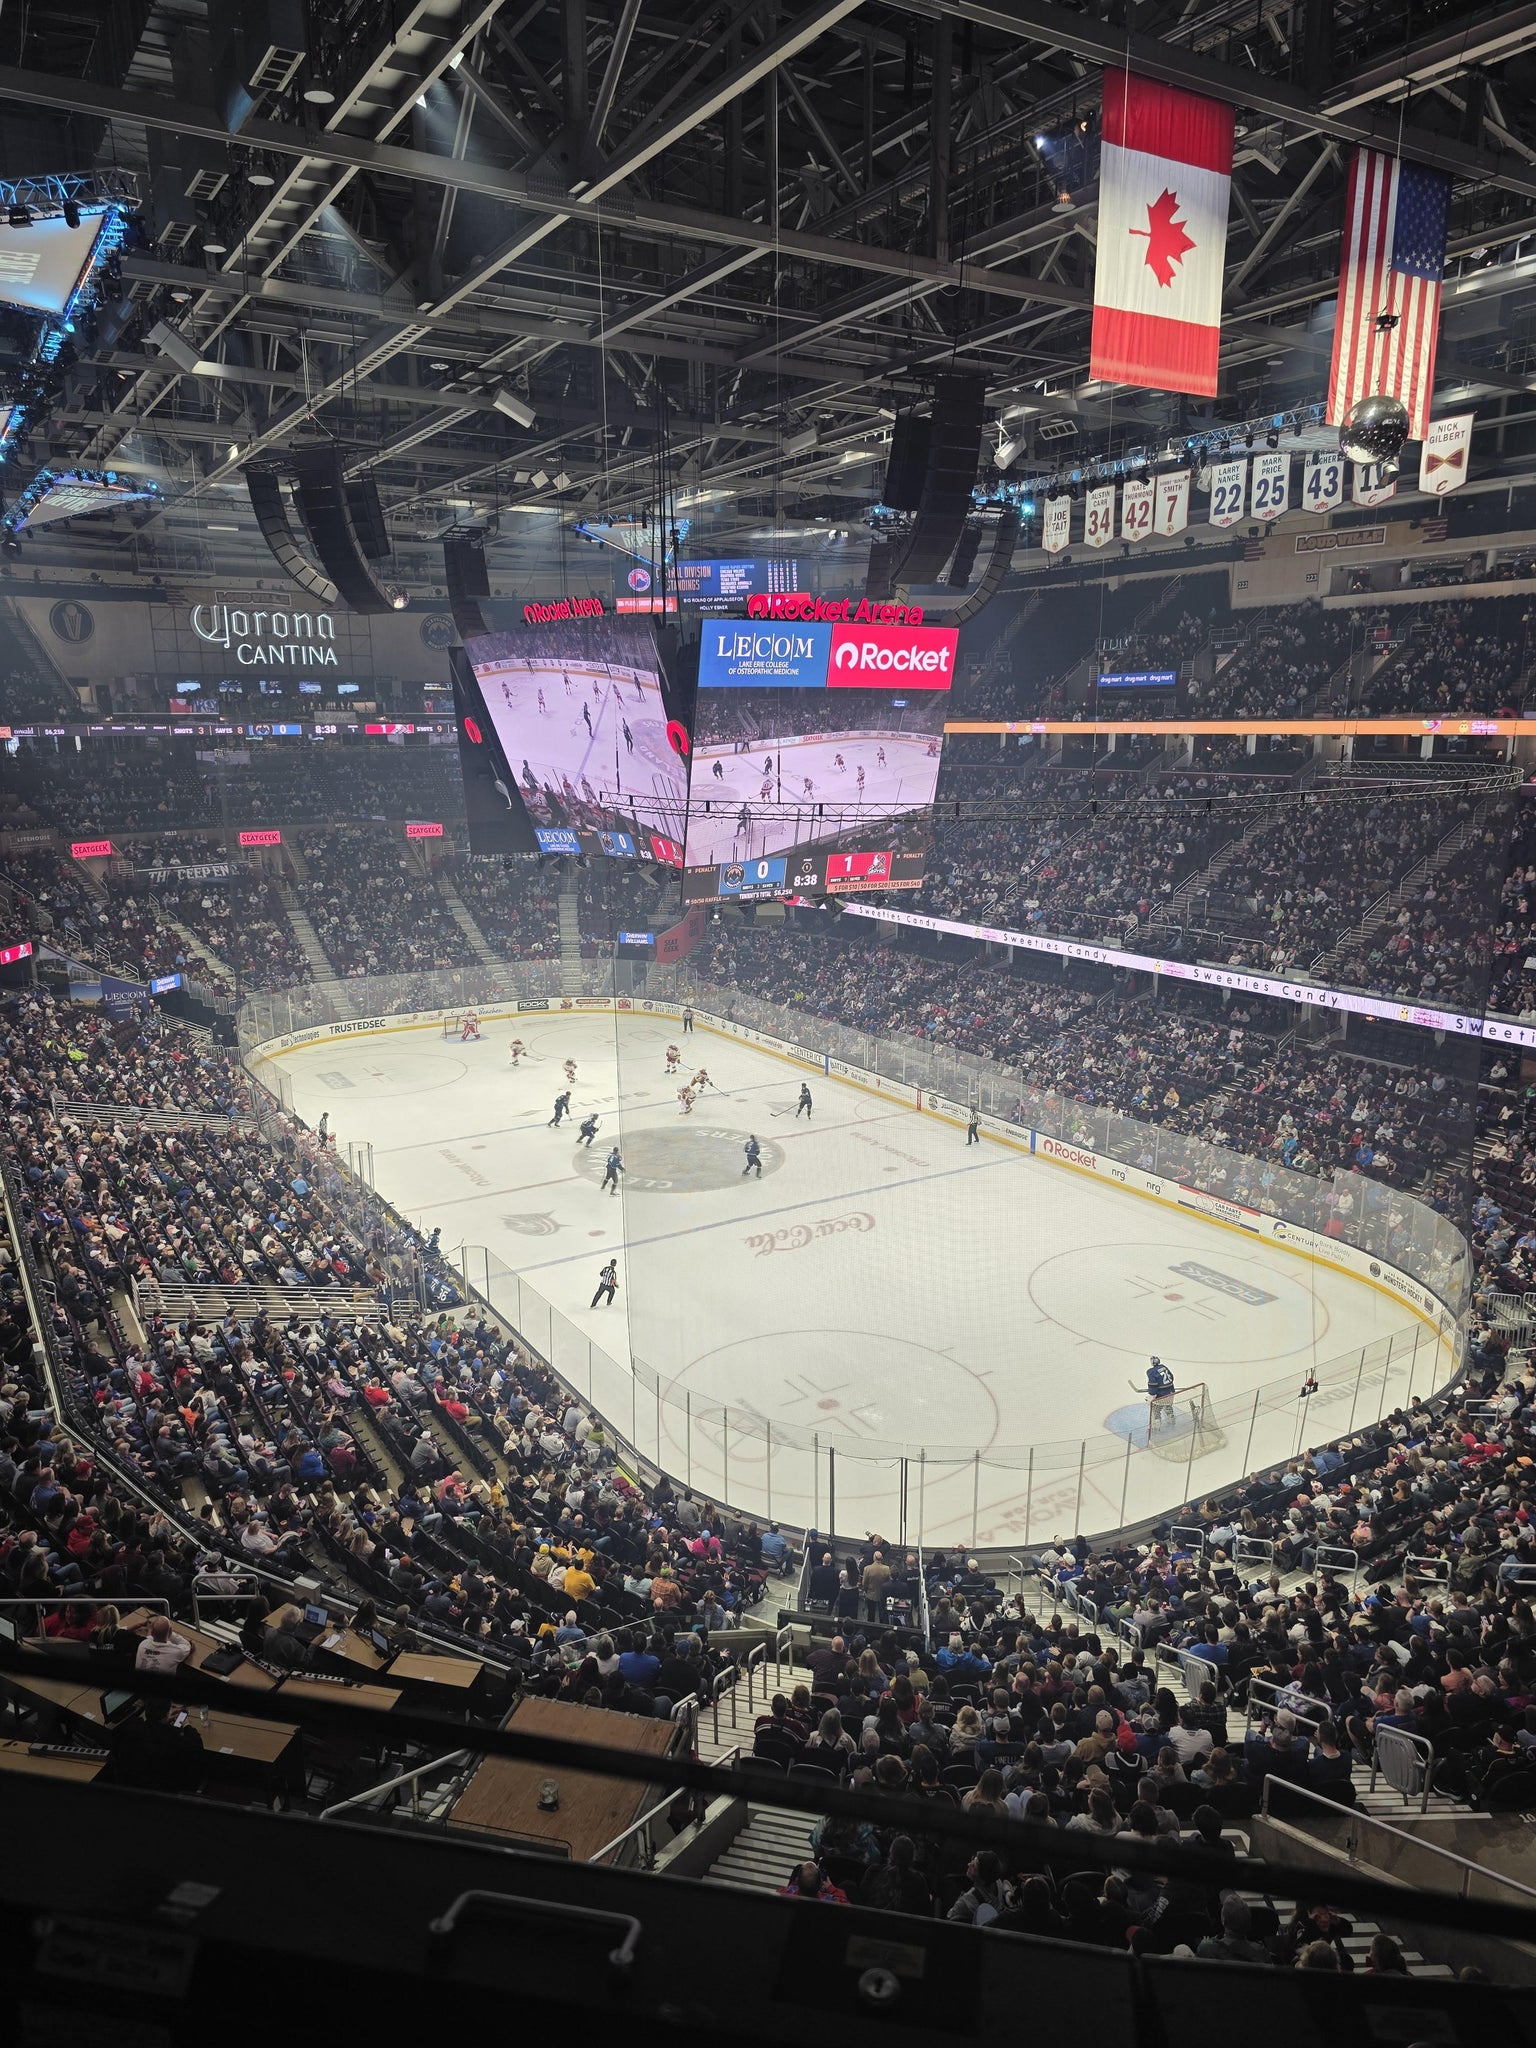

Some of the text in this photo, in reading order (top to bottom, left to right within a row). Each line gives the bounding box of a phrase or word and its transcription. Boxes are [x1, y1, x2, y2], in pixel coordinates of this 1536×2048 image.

[1438, 422, 1458, 433] NICK
[1429, 430, 1466, 444] GILBERT
[1262, 456, 1282, 467] MARK
[1218, 465, 1240, 476] LARRY
[1261, 465, 1282, 475] PRICE
[1217, 474, 1240, 484] NANCE
[1307, 466, 1339, 500] 43
[1131, 484, 1147, 492] NATE
[1163, 484, 1183, 494] SMITH
[1255, 475, 1285, 509] 25
[1090, 490, 1111, 500] AUSTIN
[1125, 489, 1153, 501] THURMOND
[1213, 483, 1242, 516] 22
[1092, 500, 1108, 508] CARR
[1167, 494, 1178, 523] 7
[1053, 510, 1067, 521] JOE
[1125, 500, 1150, 530] 42
[1051, 520, 1067, 532] TAIT
[1088, 507, 1111, 537] 34
[684, 565, 712, 578] DIVISION
[666, 579, 700, 592] STANDINGS
[535, 595, 605, 622] Rocket Arena
[771, 594, 923, 625] Rocket Arena
[190, 605, 336, 649] Corona
[237, 643, 339, 666] CANTINA
[861, 643, 950, 672] Rocket
[766, 661, 789, 669] COLLEGE
[1161, 673, 1173, 681] mart
[198, 726, 204, 735] 3
[237, 725, 243, 734] 8
[280, 725, 286, 734] 0
[315, 725, 337, 734] 8:38
[381, 725, 386, 733] 1
[436, 725, 443, 733] 9
[408, 825, 441, 835] SEATGEEK
[242, 834, 278, 843] SEATGEEK
[618, 834, 627, 849] 0
[73, 844, 108, 855] SEATGEEK
[658, 840, 667, 856] 1
[695, 866, 716, 874] PENALTY
[757, 861, 769, 879] 0
[844, 855, 853, 873] 1
[793, 874, 818, 887] 8:38
[858, 905, 938, 930] Sweeties Candy
[1003, 933, 1060, 952] Sweeties
[1067, 944, 1108, 963] Candy
[5, 951, 10, 961] 9
[156, 975, 175, 986] SHERWIN
[1193, 967, 1270, 993] Sweeties
[1282, 984, 1338, 1008] Candy
[329, 1018, 386, 1035] TRUSTEDSEC
[1456, 1017, 1536, 1044] Sweeti
[794, 1046, 822, 1063] CENTER ICE
[1054, 1142, 1097, 1169] Rocket
[1111, 1168, 1126, 1181] nrg
[1146, 1181, 1161, 1194] nrg
[1215, 1202, 1242, 1216] CAR PARTS
[1287, 1232, 1319, 1249] CENTURY
[1383, 1273, 1423, 1303] MONSTERS HOCKEY
